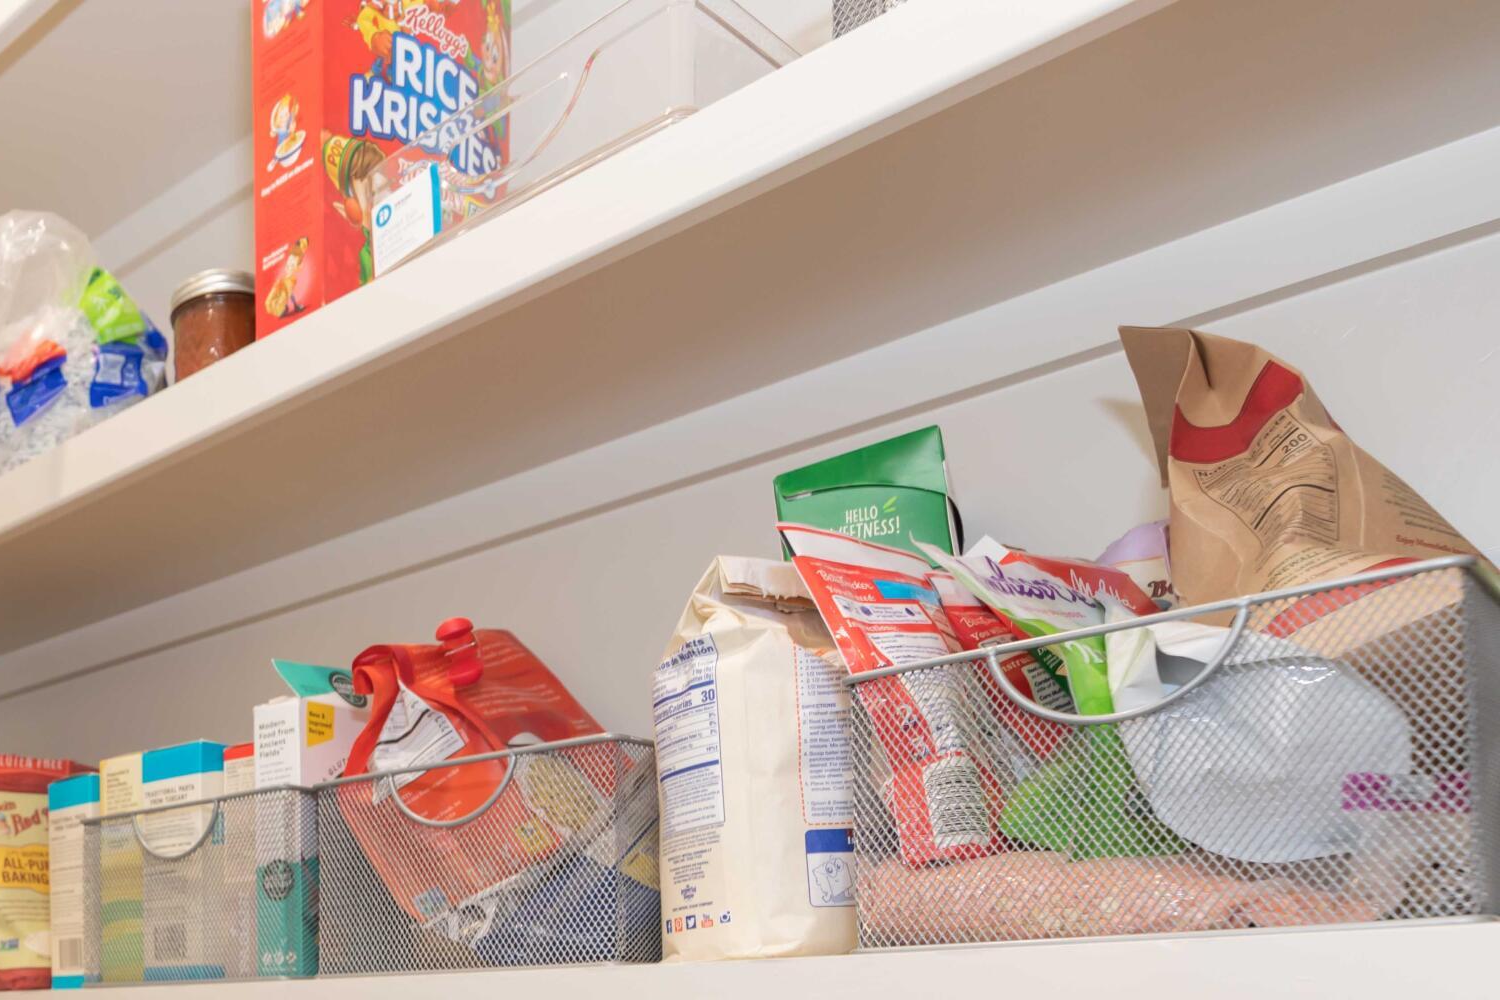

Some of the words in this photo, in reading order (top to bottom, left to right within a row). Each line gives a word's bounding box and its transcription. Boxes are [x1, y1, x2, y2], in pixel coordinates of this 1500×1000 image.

[404, 4, 469, 59] Kellogg's
[395, 36, 477, 111] RICE
[1282, 433, 1308, 454] 200
[845, 506, 878, 524] HELLO
[830, 515, 900, 541] EETNESS!
[701, 688, 716, 703] 30
[259, 720, 285, 730] Modern
[259, 730, 276, 739] Food
[278, 727, 295, 735] from
[259, 739, 286, 749] Ancient
[36, 758, 62, 770] FREE
[12, 812, 41, 836] Red
